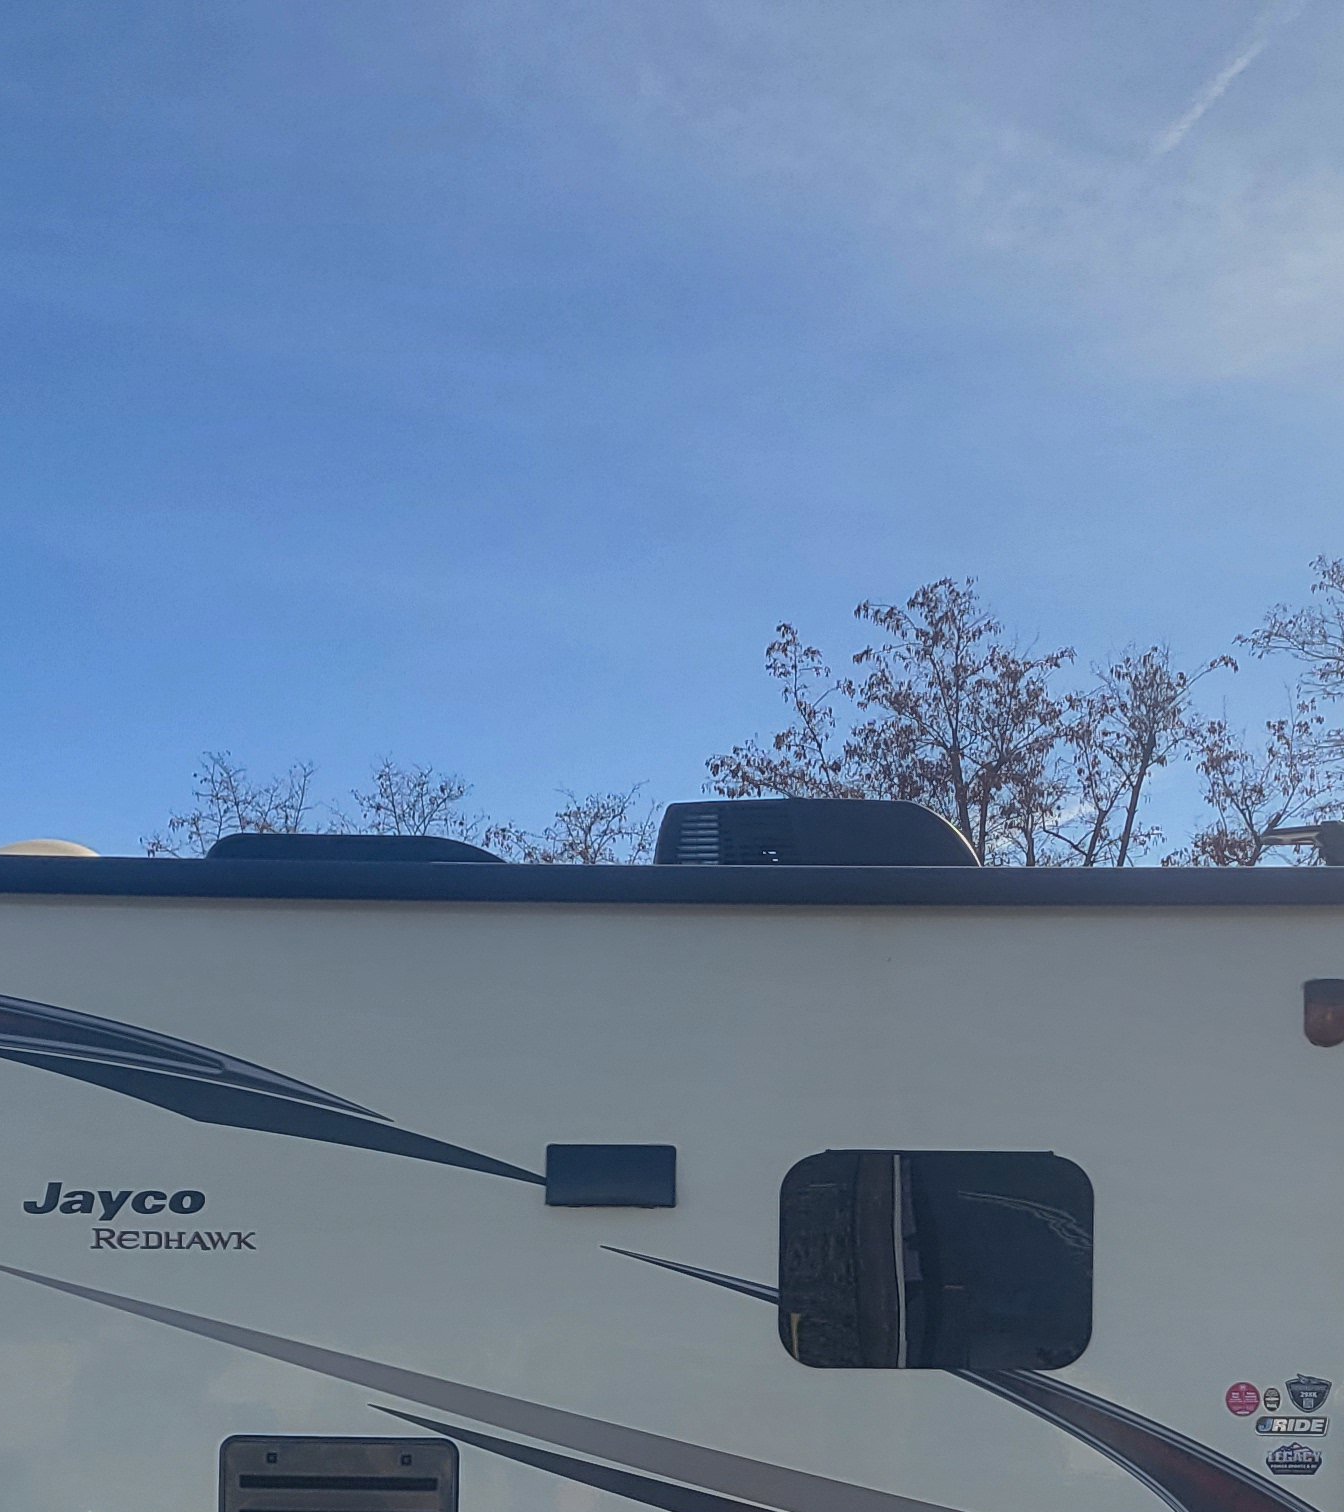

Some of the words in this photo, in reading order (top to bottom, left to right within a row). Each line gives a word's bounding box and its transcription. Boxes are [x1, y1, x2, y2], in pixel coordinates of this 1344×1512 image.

[23, 1181, 206, 1221] Jayco
[89, 1227, 257, 1251] REDHAWK
[1258, 1418, 1327, 1433] JRIDE
[1267, 1450, 1321, 1462] LEGACY
